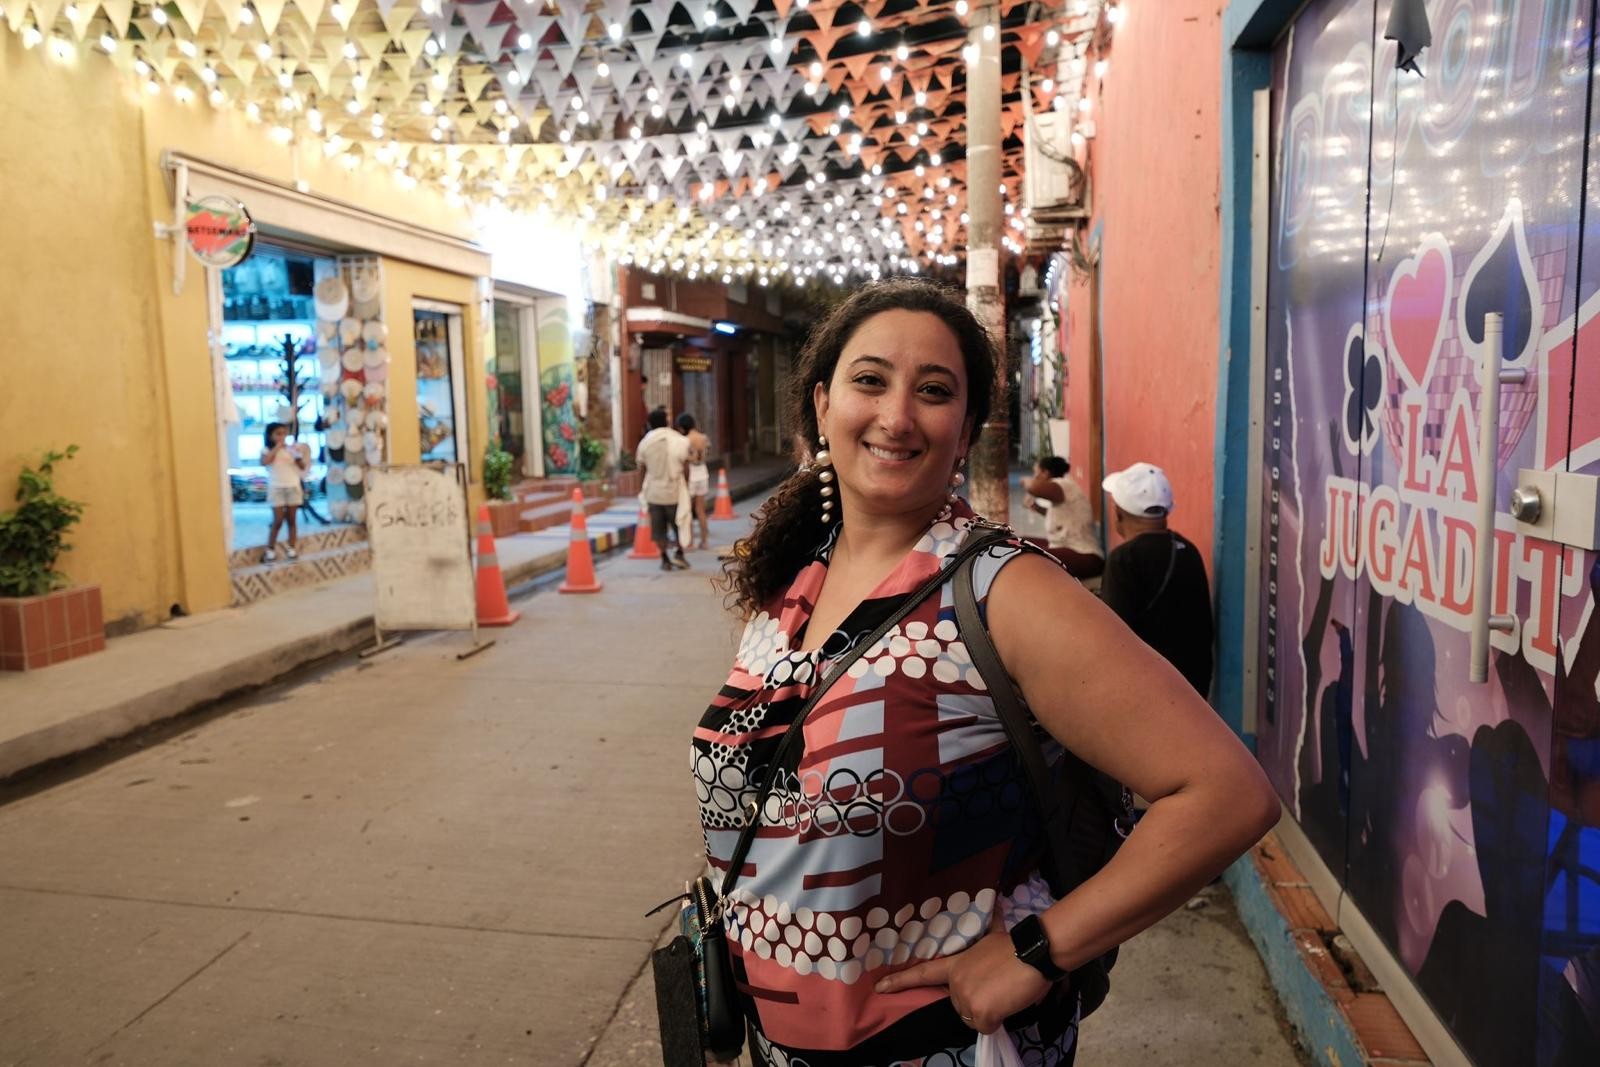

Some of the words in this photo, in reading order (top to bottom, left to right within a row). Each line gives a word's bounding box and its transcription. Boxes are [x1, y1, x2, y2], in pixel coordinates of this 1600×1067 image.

[1273, 368, 1282, 450] CLUB
[1404, 400, 1478, 504] LA
[1270, 466, 1280, 566] DISCO
[1322, 487, 1597, 656] JUGADIT
[1267, 581, 1277, 703] CASINO
